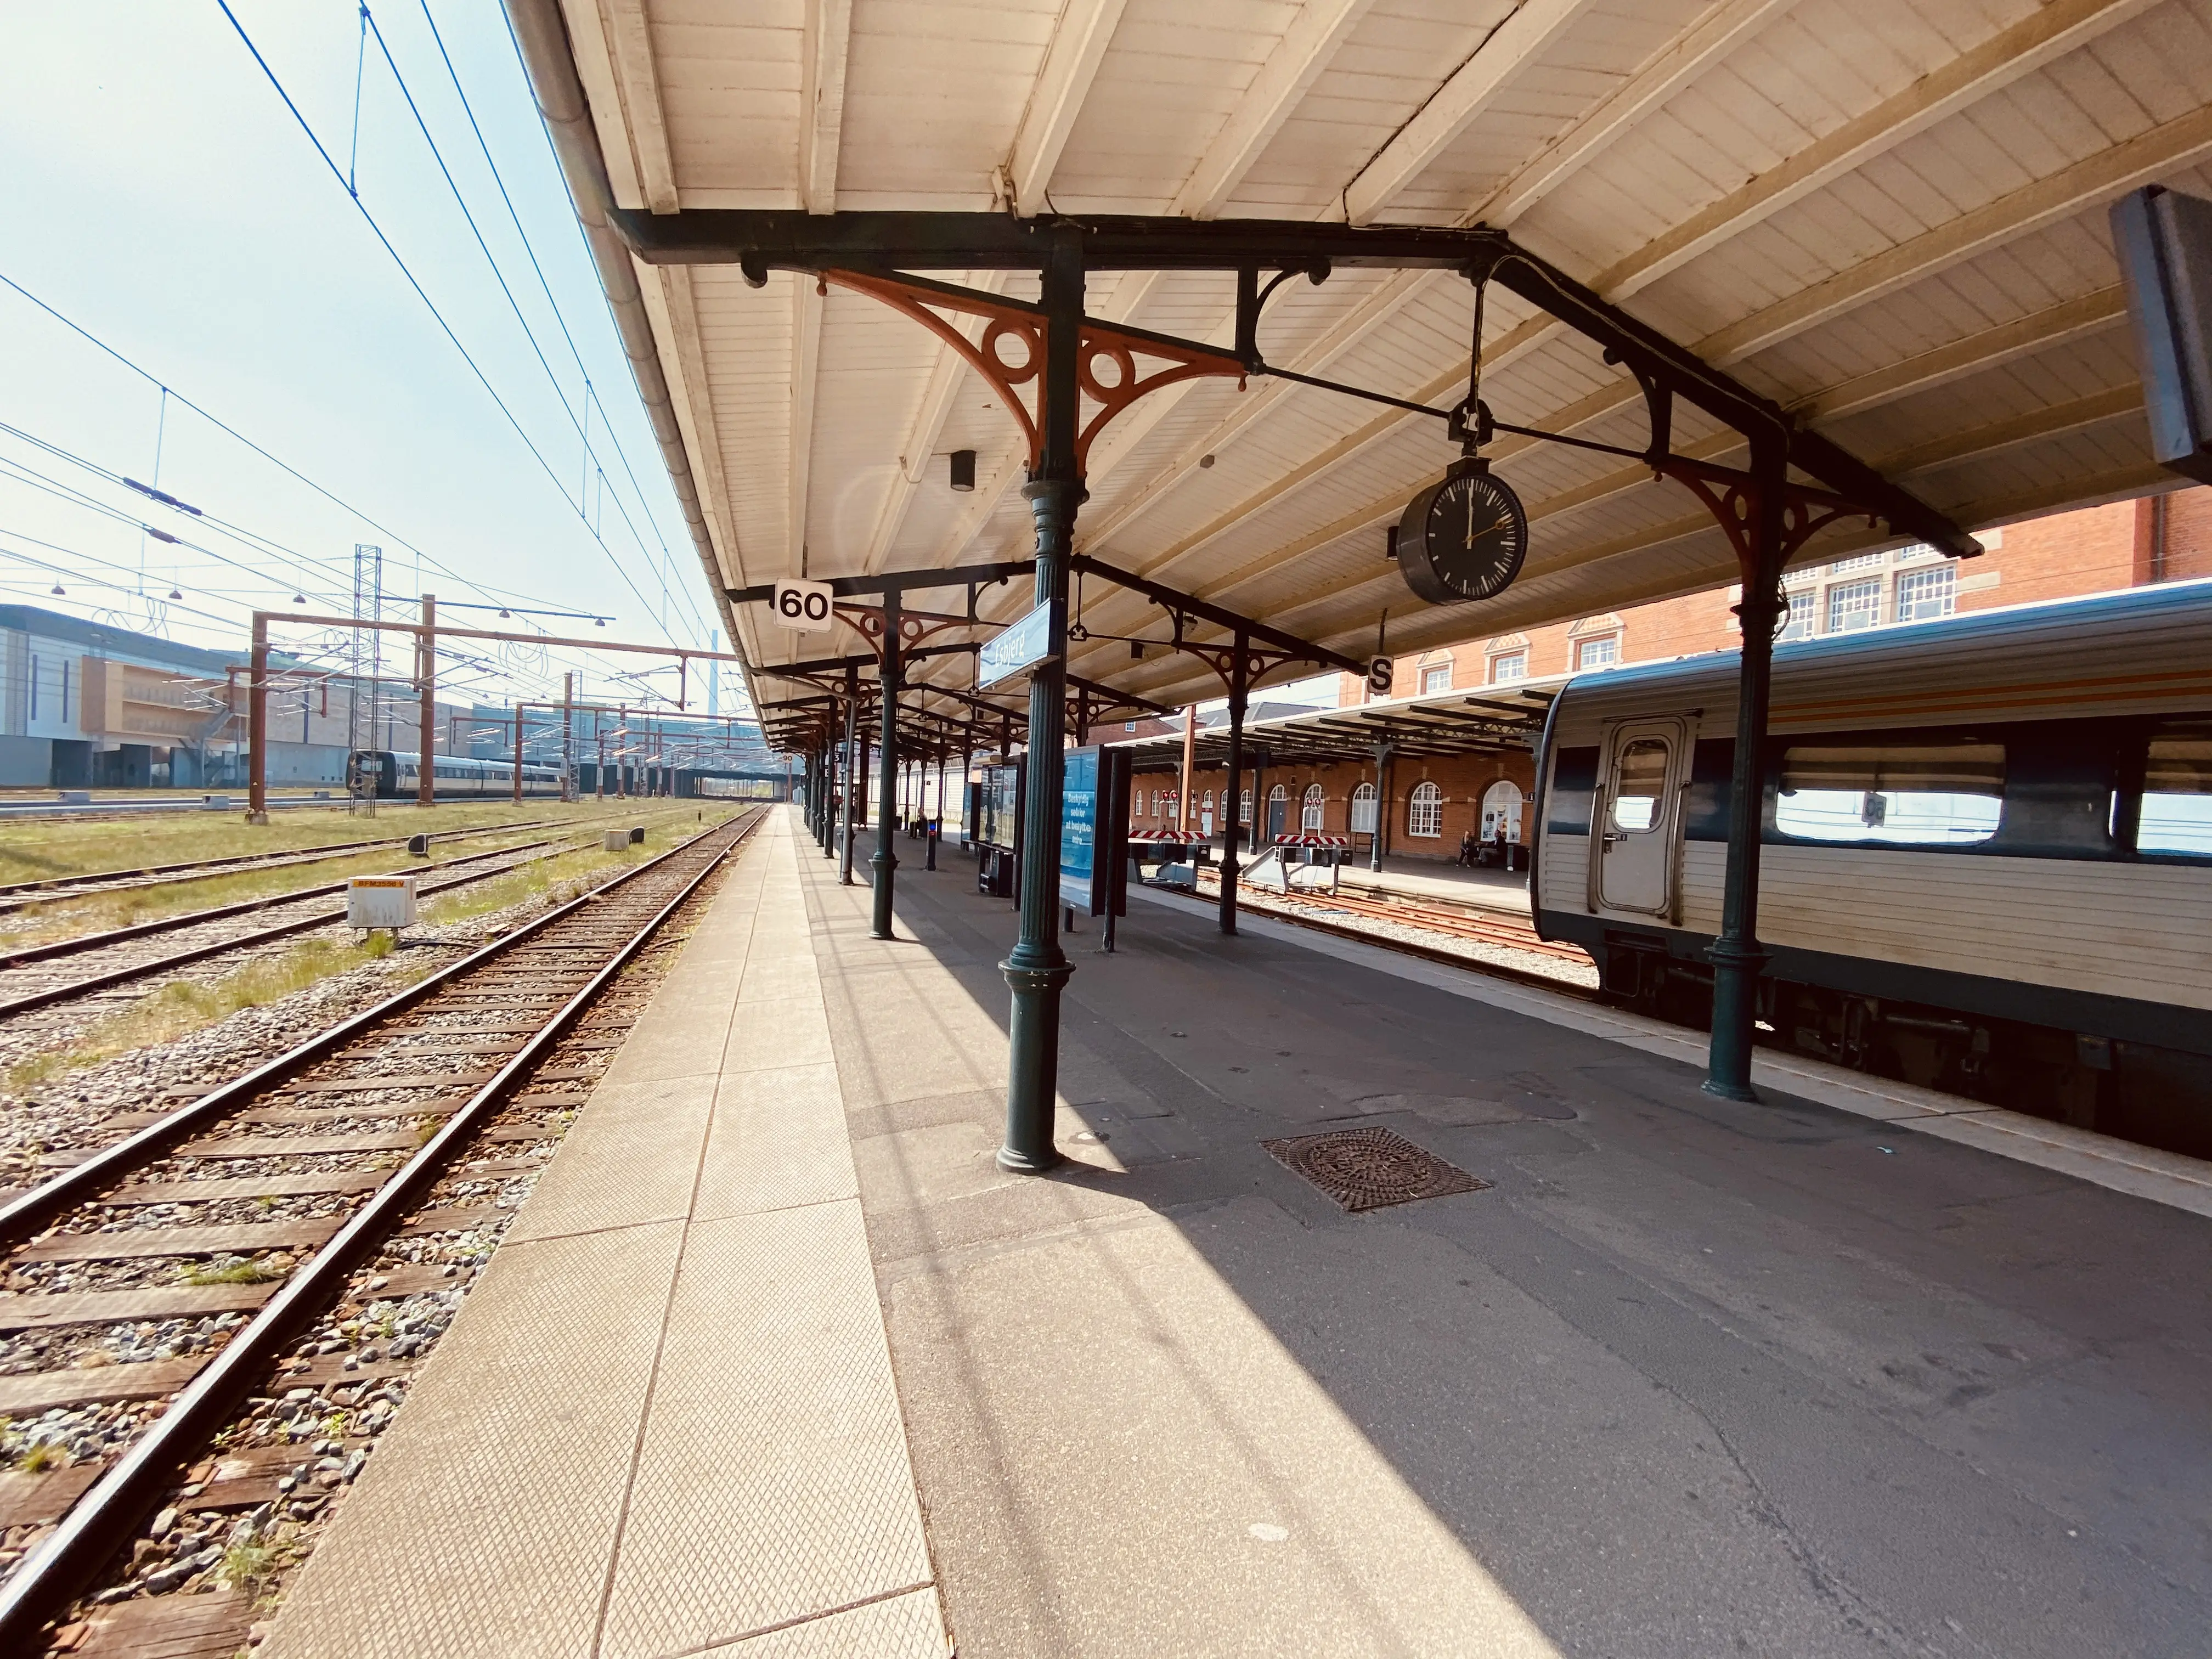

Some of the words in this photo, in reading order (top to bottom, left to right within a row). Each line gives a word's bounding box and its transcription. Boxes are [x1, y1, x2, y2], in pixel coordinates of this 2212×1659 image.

[780, 589, 828, 620] 60
[995, 630, 1025, 668] Esbjerg
[1370, 658, 1392, 690] S
